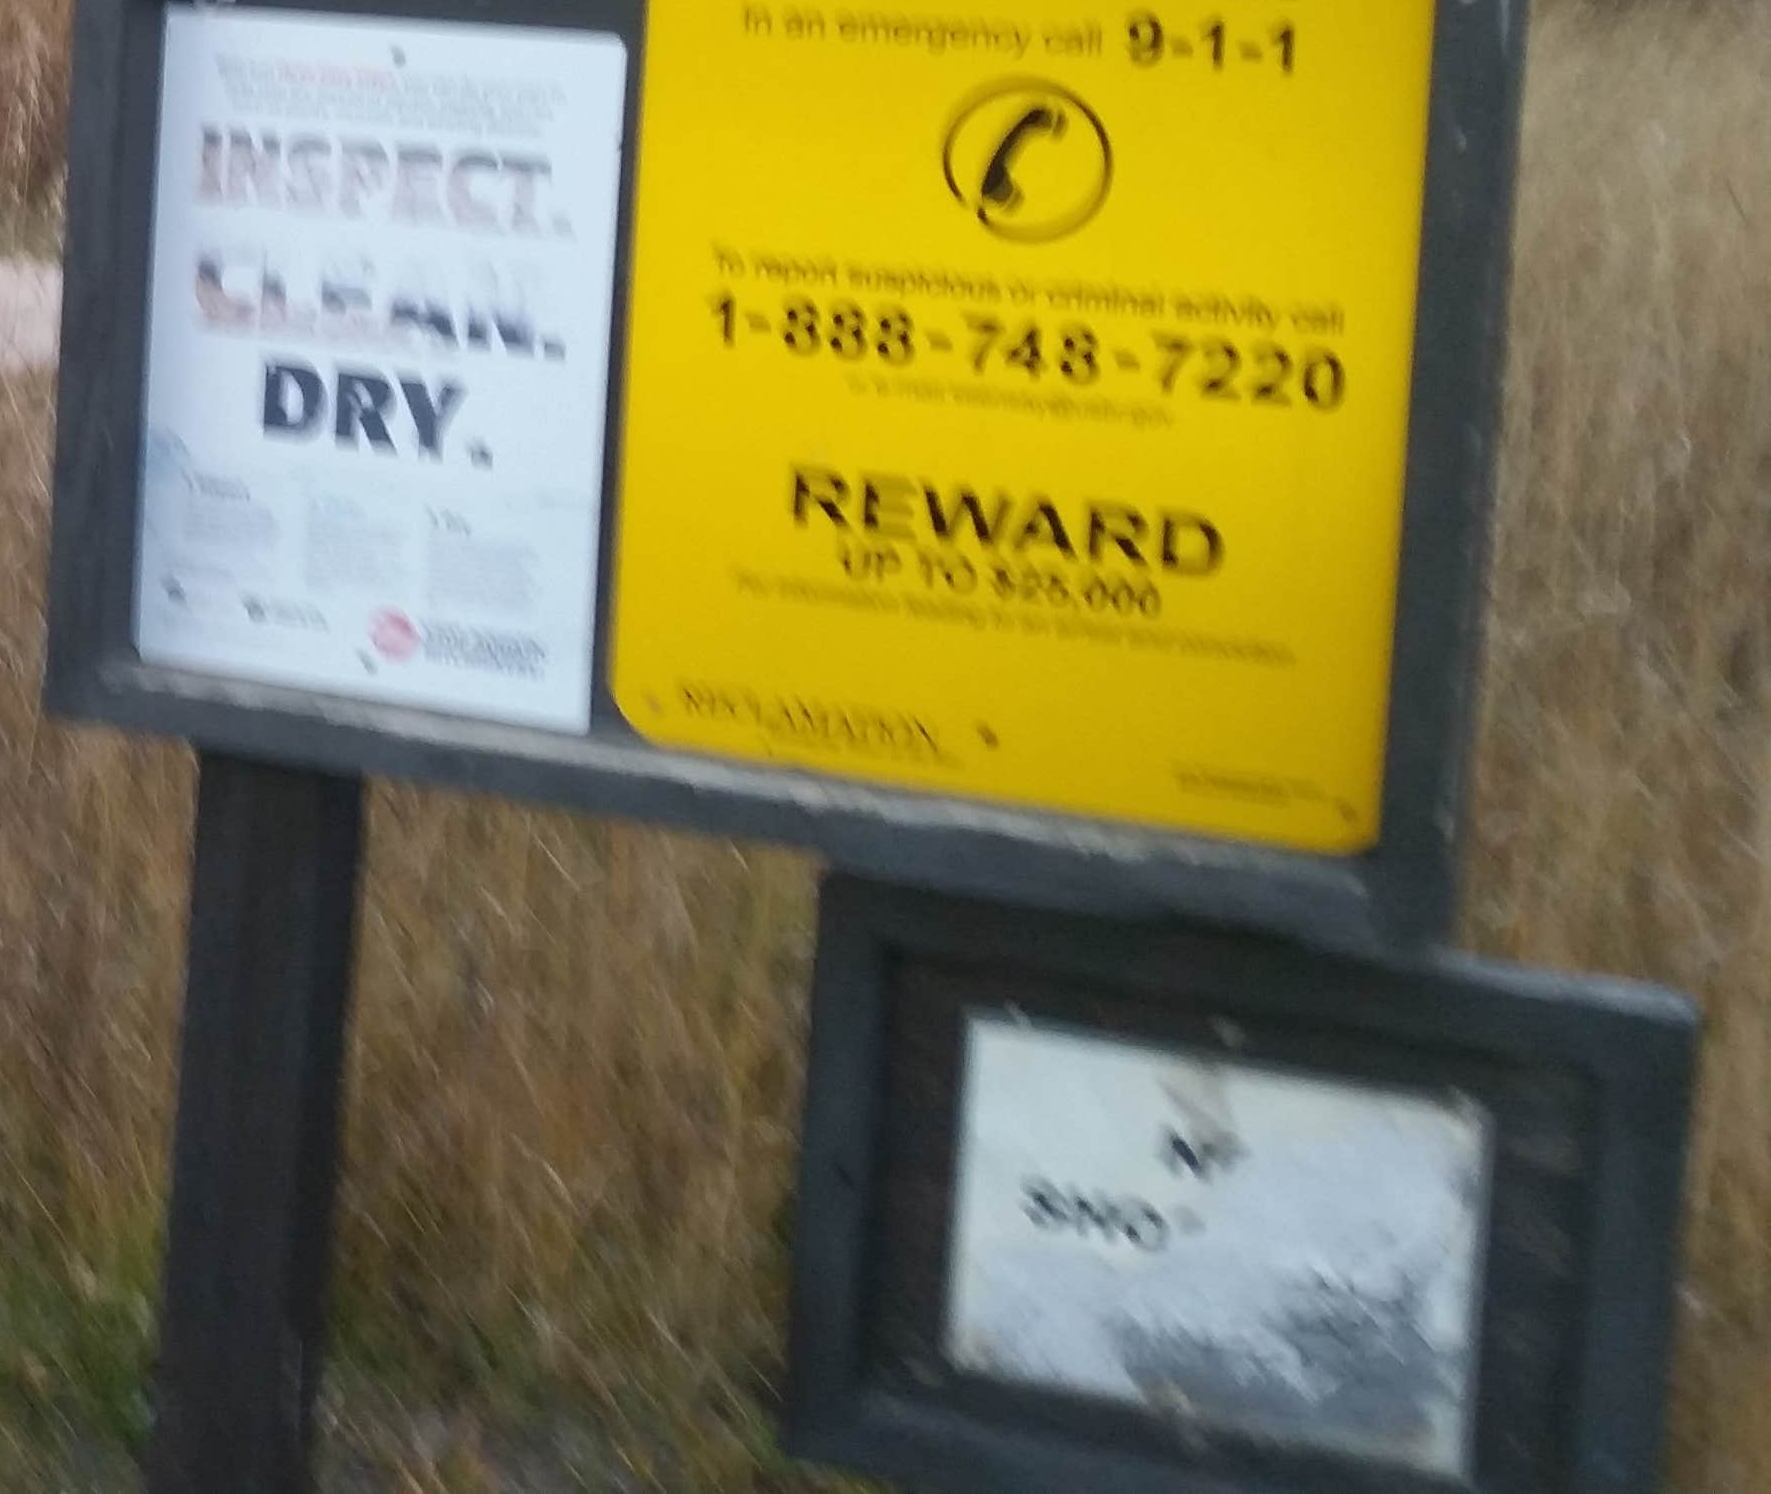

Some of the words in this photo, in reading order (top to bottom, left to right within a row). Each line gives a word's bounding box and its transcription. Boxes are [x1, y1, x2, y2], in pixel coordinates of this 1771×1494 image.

[743, 2, 772, 34] In
[785, 10, 825, 41] an
[838, 15, 1032, 61] emergency
[1043, 17, 1103, 58] call
[1126, 10, 1297, 74] 9-1-1
[712, 292, 1346, 414] 1-888-748-7220
[262, 359, 493, 468] DRY.
[790, 461, 1226, 578] REWARD
